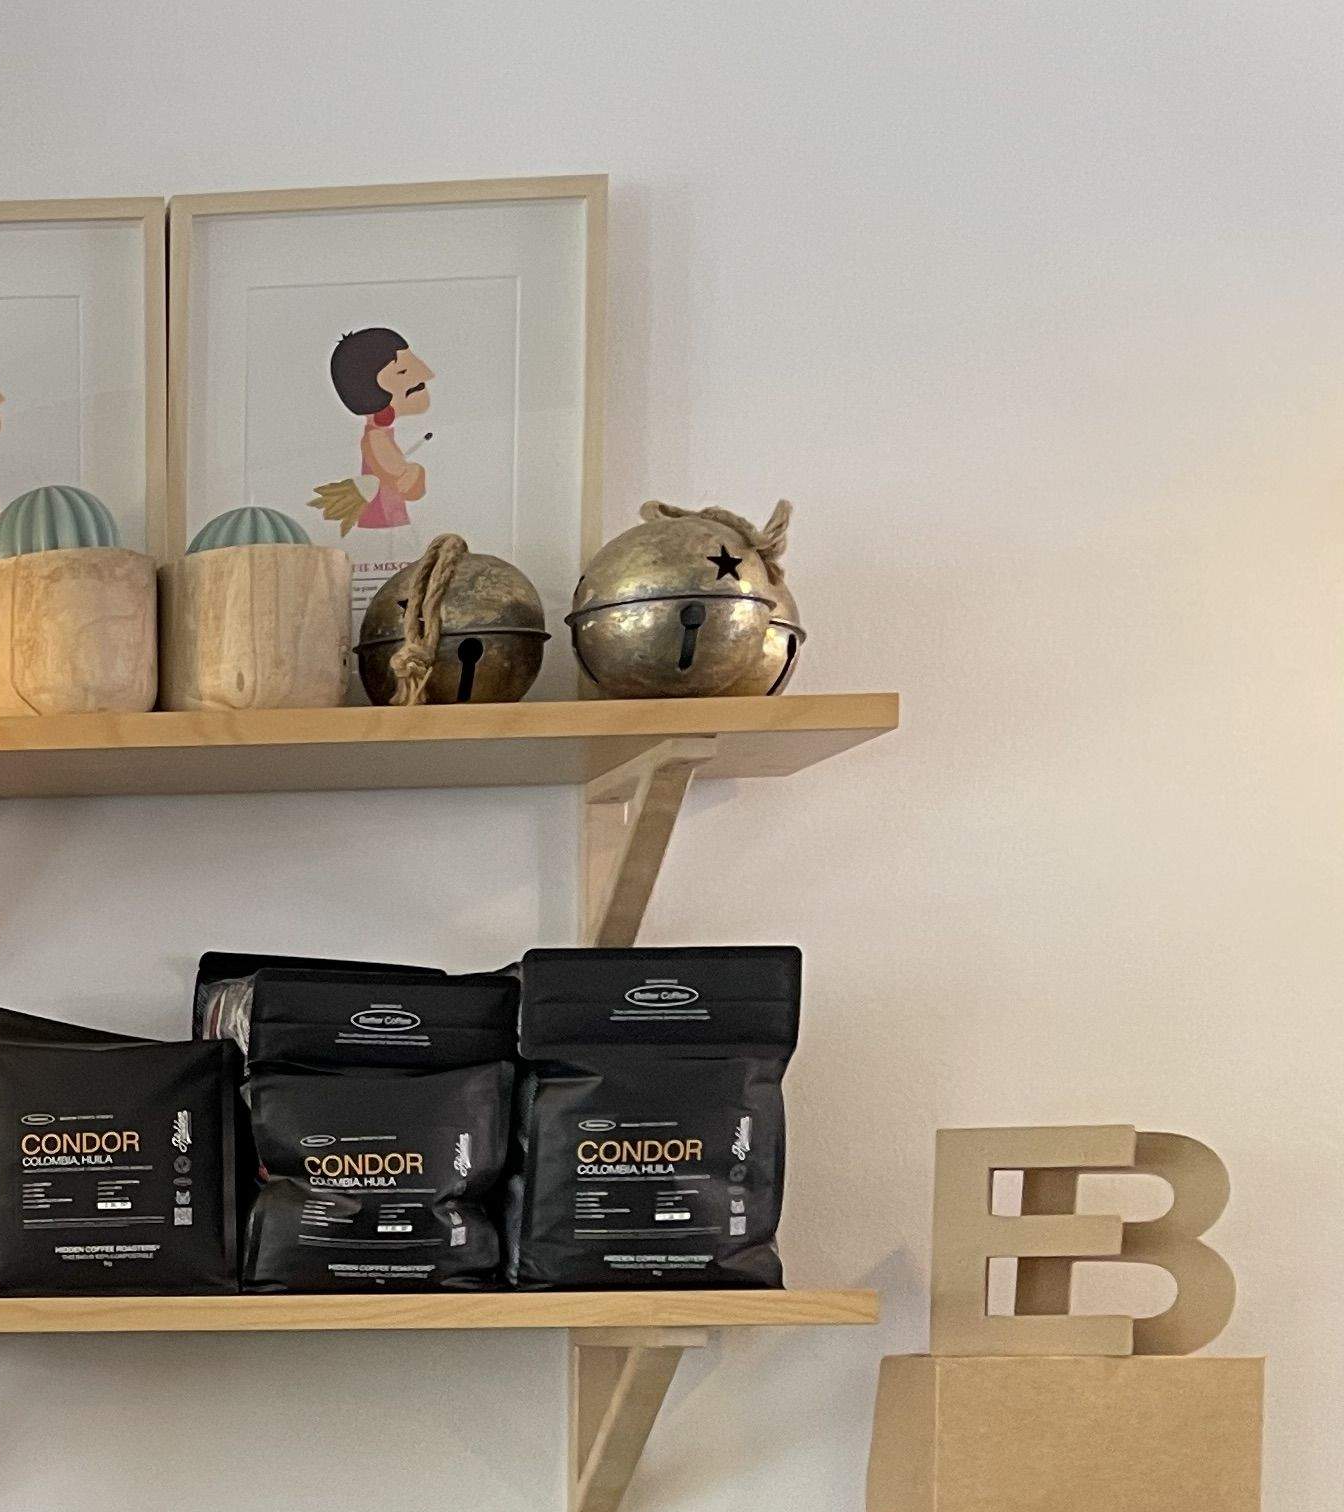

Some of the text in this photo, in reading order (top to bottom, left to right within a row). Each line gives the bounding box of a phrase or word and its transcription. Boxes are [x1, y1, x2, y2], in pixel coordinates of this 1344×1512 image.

[21, 1131, 140, 1155] CONDOR
[577, 1139, 703, 1163] CONDOR
[22, 1155, 113, 1166] COLOMBIA, HUILA
[304, 1153, 423, 1177] CONDOR
[642, 1163, 675, 1174] HUILA
[364, 1176, 397, 1186] HUILA
